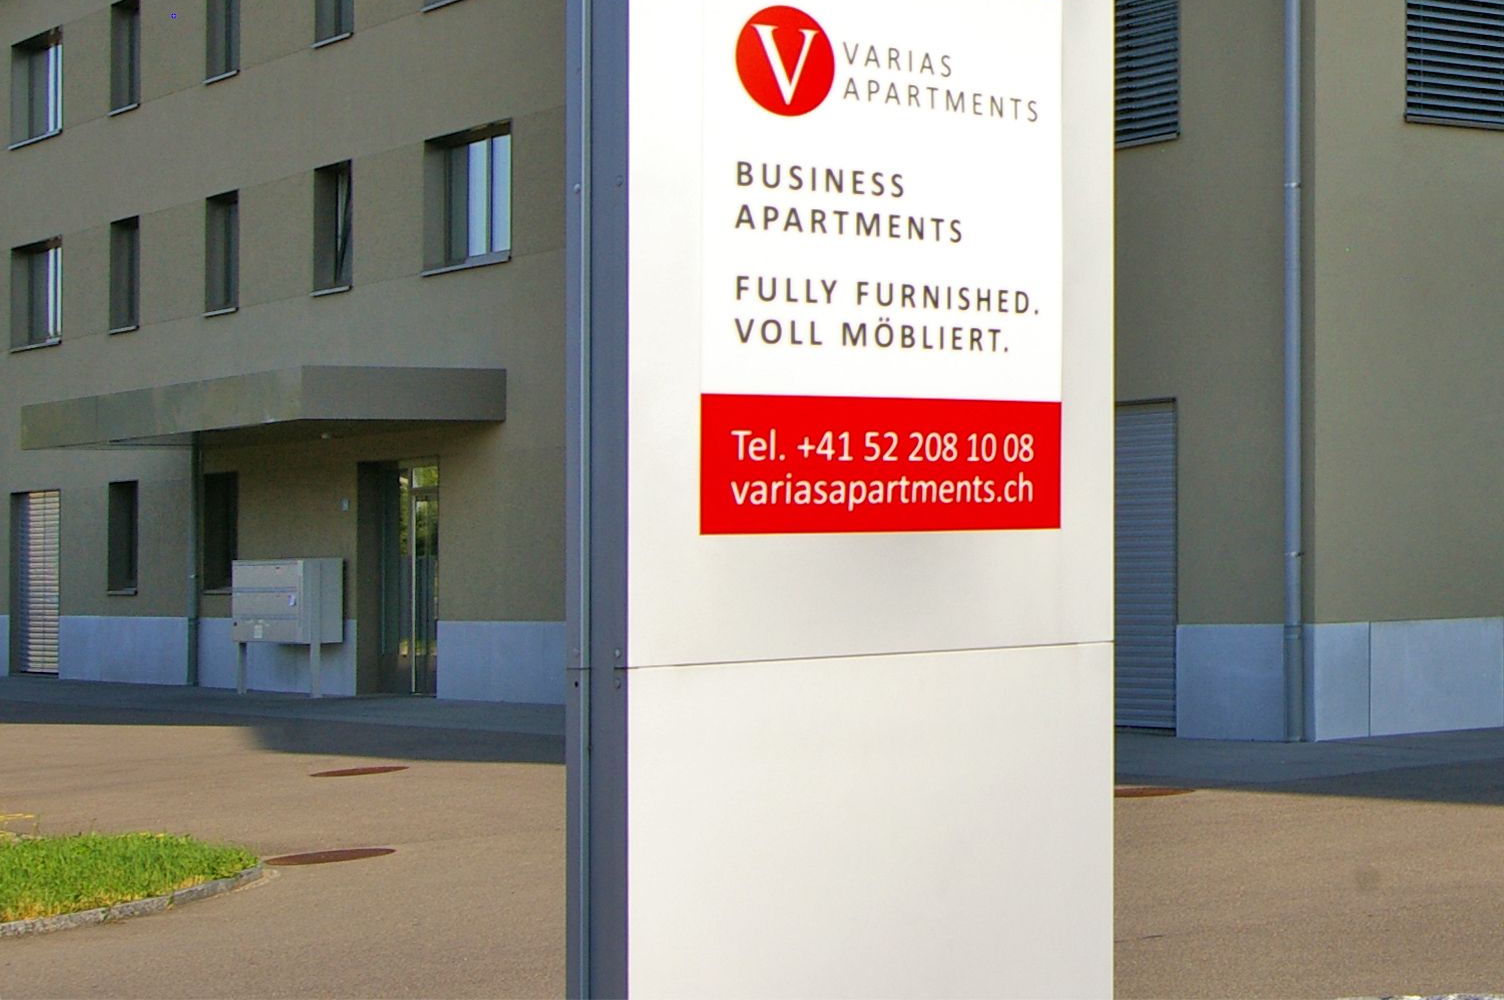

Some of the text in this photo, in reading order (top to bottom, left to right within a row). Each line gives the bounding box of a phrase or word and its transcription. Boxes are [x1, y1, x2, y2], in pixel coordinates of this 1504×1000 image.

[749, 23, 820, 106] V
[843, 41, 952, 78] VARIAS
[843, 77, 1039, 123] APARTMENTS
[736, 161, 905, 198] BUSINESS
[735, 204, 963, 243] APARTMENTS
[735, 275, 1040, 315] FULLY FURNISHED.
[734, 317, 1009, 353] VOLL MÖBLIERT.
[731, 429, 1035, 462] Tel. +41 52 208 10 08
[731, 472, 1034, 512] variasapartments.ch
